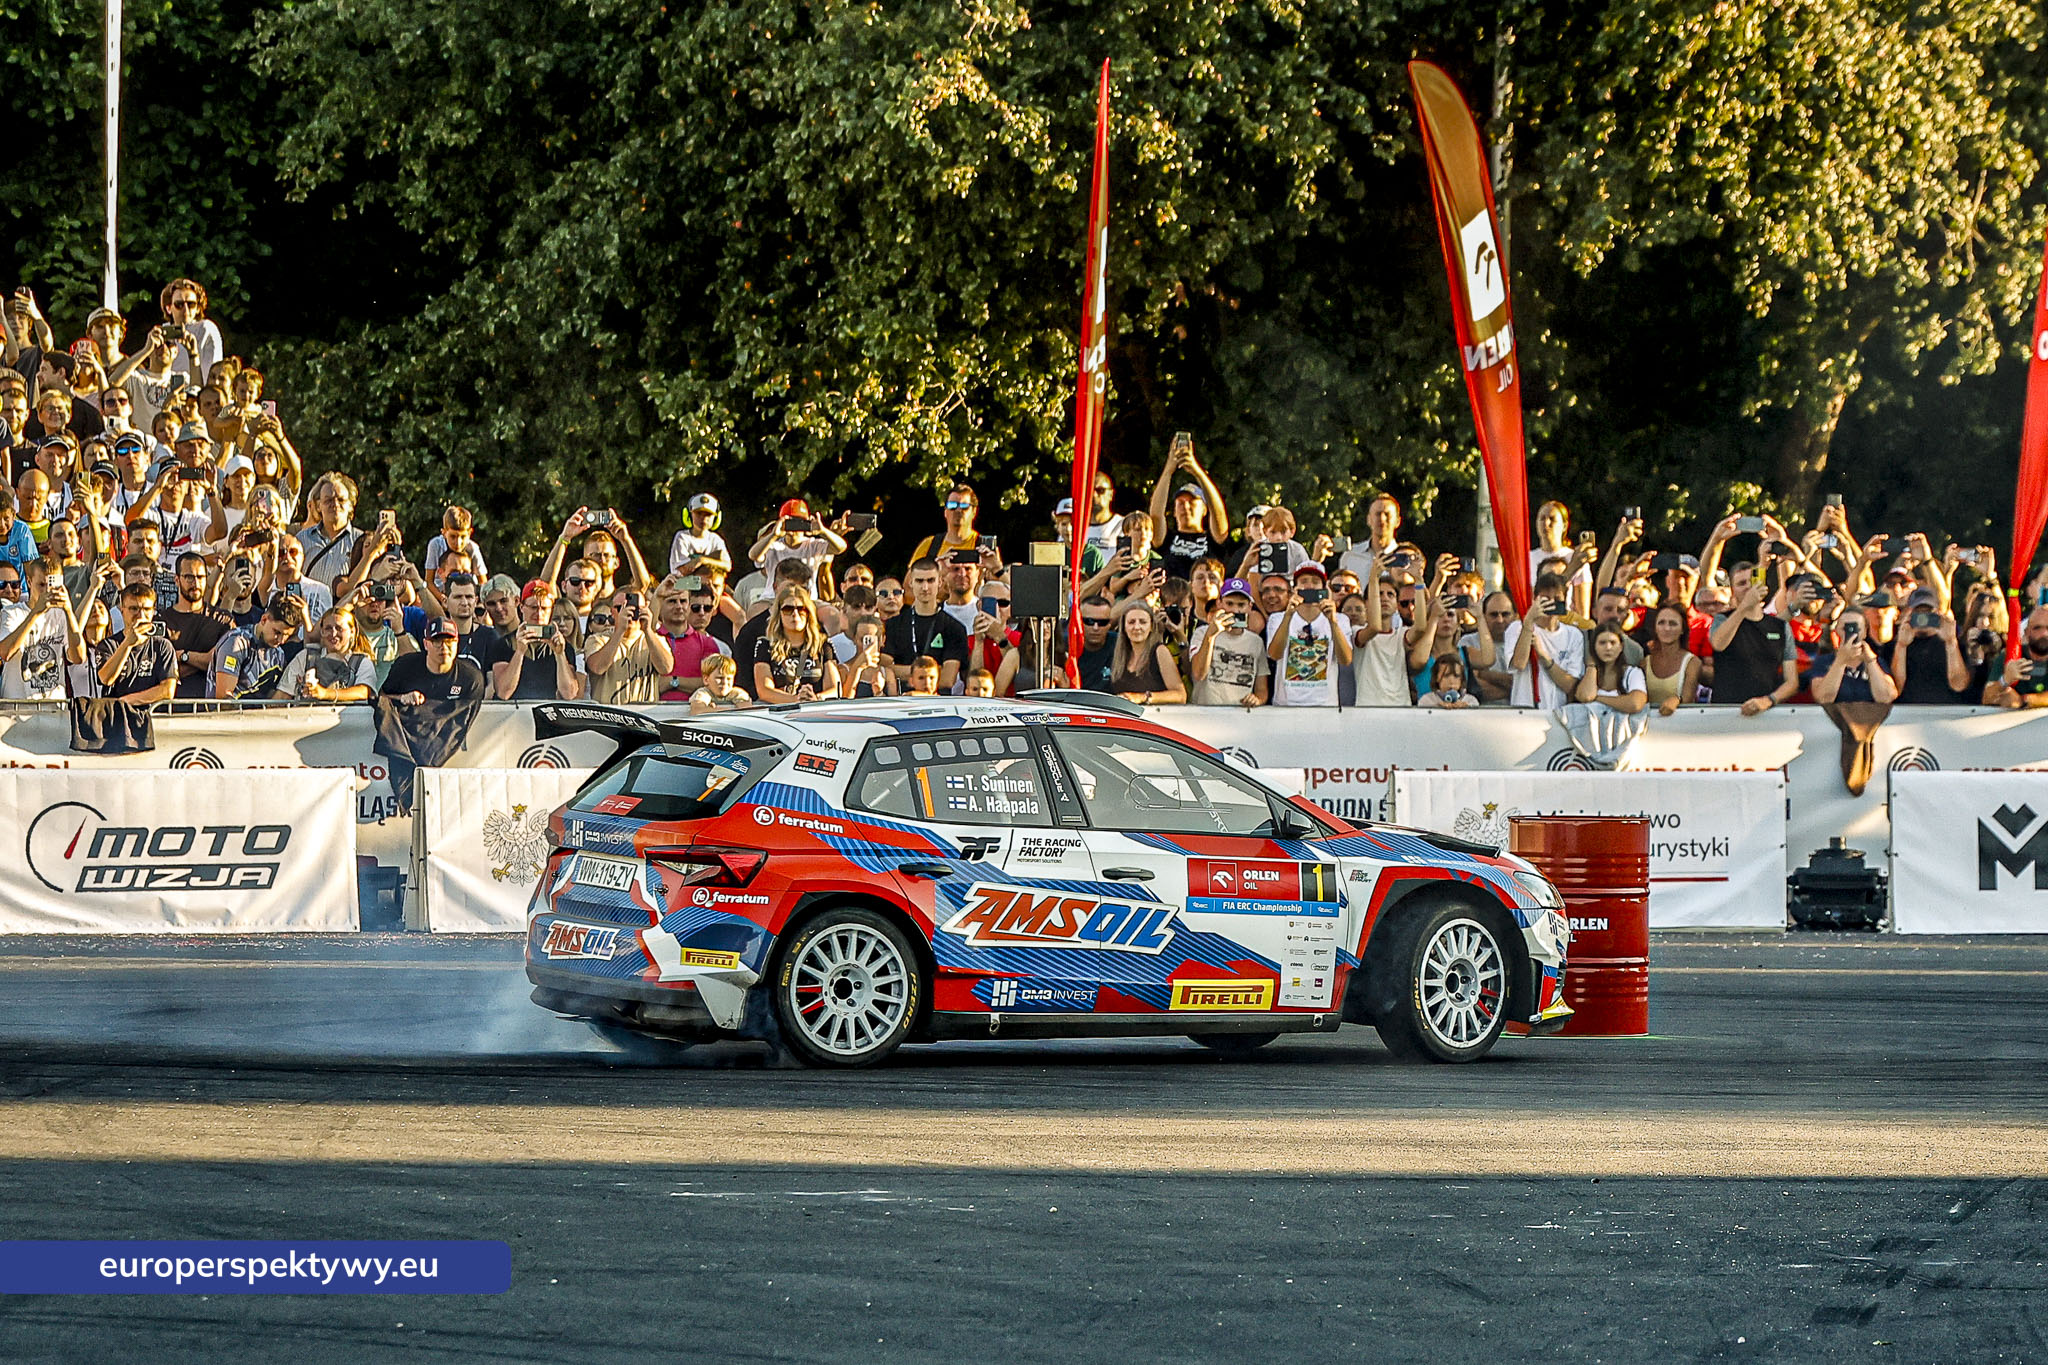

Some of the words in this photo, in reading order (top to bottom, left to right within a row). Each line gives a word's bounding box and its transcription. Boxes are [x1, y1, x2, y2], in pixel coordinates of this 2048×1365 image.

[971, 714, 1010, 725] halo.P1
[682, 731, 735, 748] SKODA
[805, 738, 838, 752] auriol
[797, 754, 837, 772] ETS
[914, 766, 936, 818] 1
[965, 775, 978, 791] T.
[981, 775, 1034, 793] Suninen
[968, 795, 983, 812] A.
[986, 797, 1040, 817] Haapala
[778, 814, 844, 834] ferratum
[87, 824, 292, 858] MOTO
[1022, 837, 1043, 846] THE
[1045, 838, 1082, 848] RACING
[1018, 846, 1067, 857] FACTORY
[81, 866, 273, 889] WIZJA
[1242, 869, 1280, 882] ORLEN
[1312, 863, 1324, 902] 1
[1243, 882, 1259, 890] OIL
[712, 890, 770, 905] ferratum
[1222, 901, 1235, 910] FIA
[1236, 902, 1251, 911] ERC
[1252, 903, 1303, 914] Championship
[954, 887, 1171, 949] AMSOIL
[1569, 917, 1609, 930] RLEN
[545, 922, 617, 957] AMSOIL
[685, 951, 734, 966] PIRELLI
[1053, 990, 1096, 1001] INVEST
[1181, 983, 1265, 1006] PIRELLI
